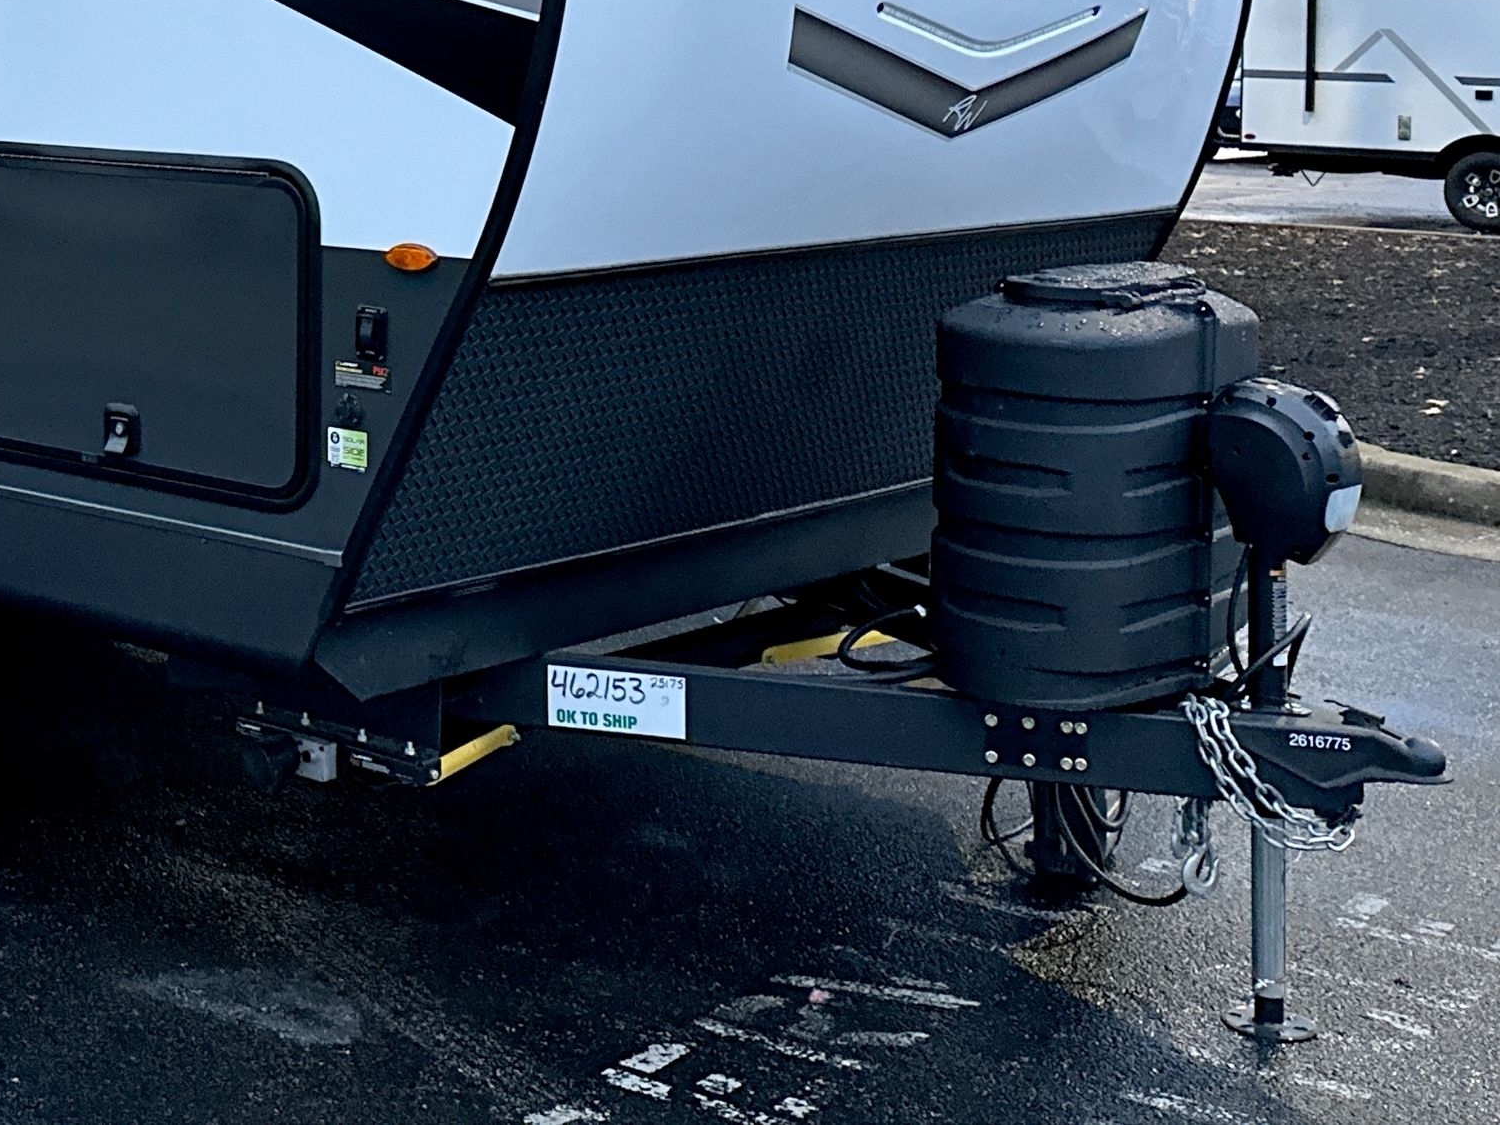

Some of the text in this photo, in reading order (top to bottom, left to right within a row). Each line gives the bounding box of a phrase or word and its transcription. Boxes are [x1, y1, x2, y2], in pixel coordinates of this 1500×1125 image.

[551, 669, 646, 704] 462153
[556, 708, 638, 729] OK TO SHIP
[1288, 732, 1352, 751] 2616775
